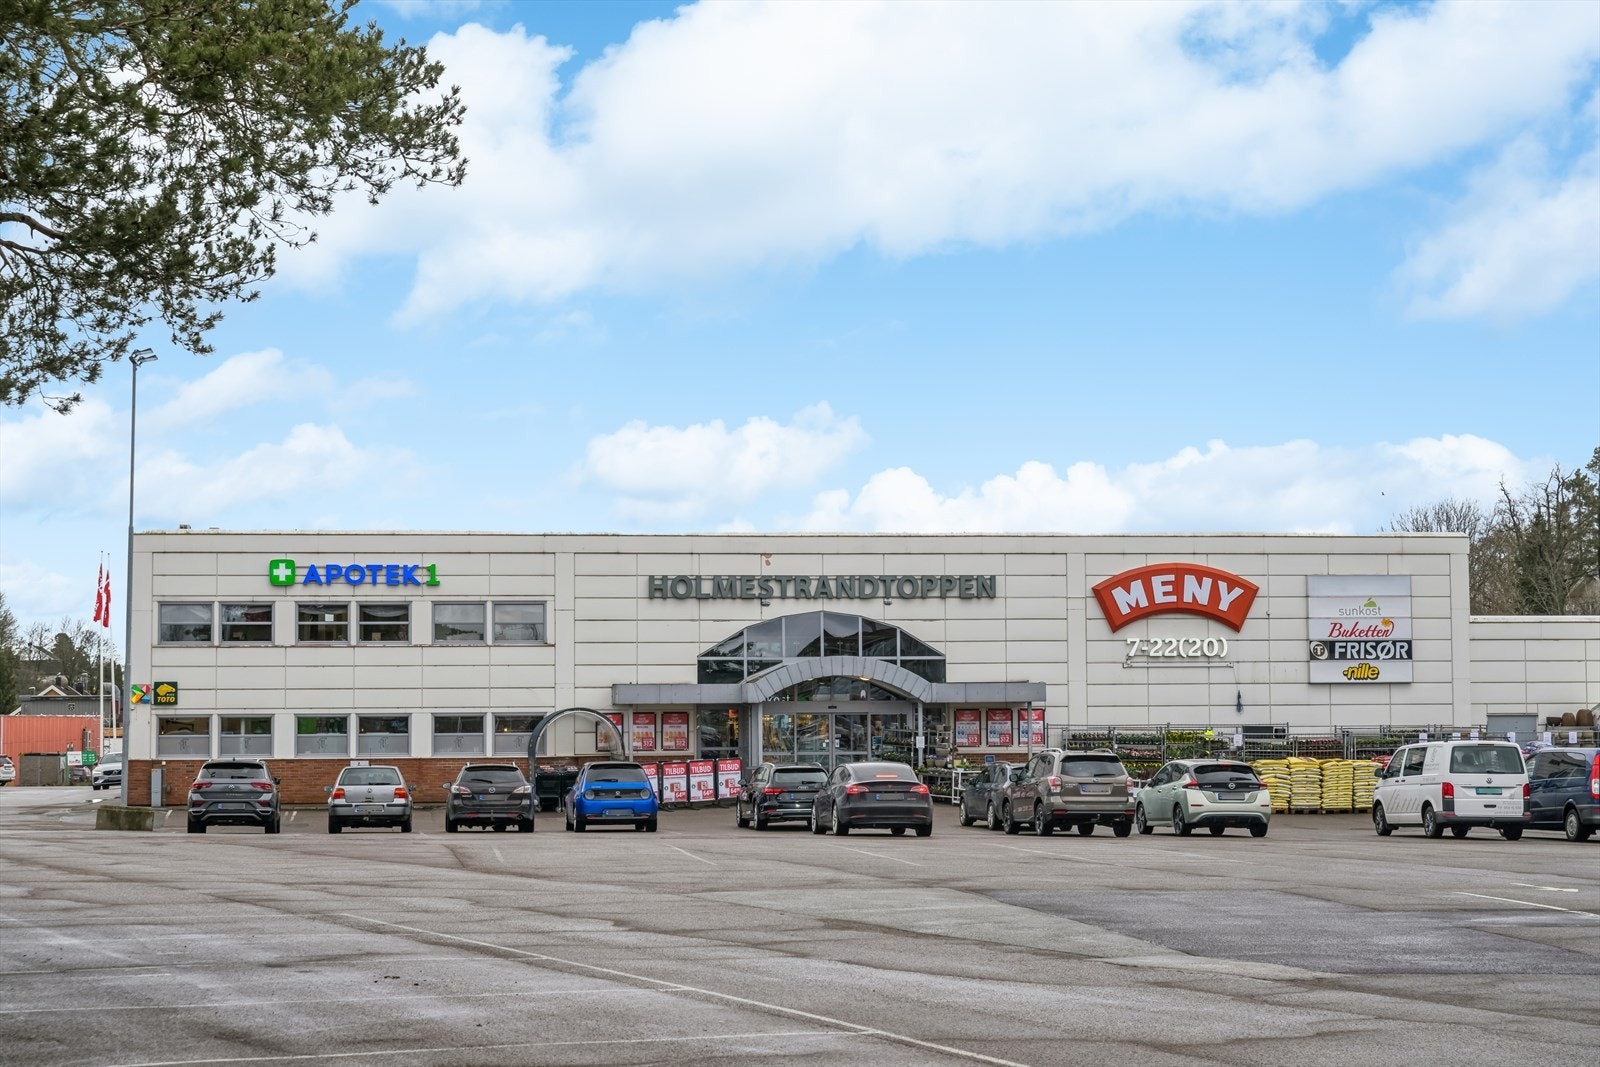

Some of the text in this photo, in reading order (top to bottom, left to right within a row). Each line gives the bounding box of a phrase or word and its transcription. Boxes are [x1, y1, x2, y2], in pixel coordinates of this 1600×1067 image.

[303, 563, 441, 586] APOTEK 1
[649, 575, 996, 599] HOLMESTRANDTOPPEN
[1111, 574, 1244, 616] MENY
[1338, 606, 1381, 616] sunkost
[1328, 620, 1394, 638] Buketten
[1126, 637, 1228, 658] 7-22(20)
[1334, 641, 1409, 660] FRISØR
[665, 767, 685, 775] TILBUD
[692, 765, 711, 773] TILBUD
[720, 763, 739, 771] TILBUD
